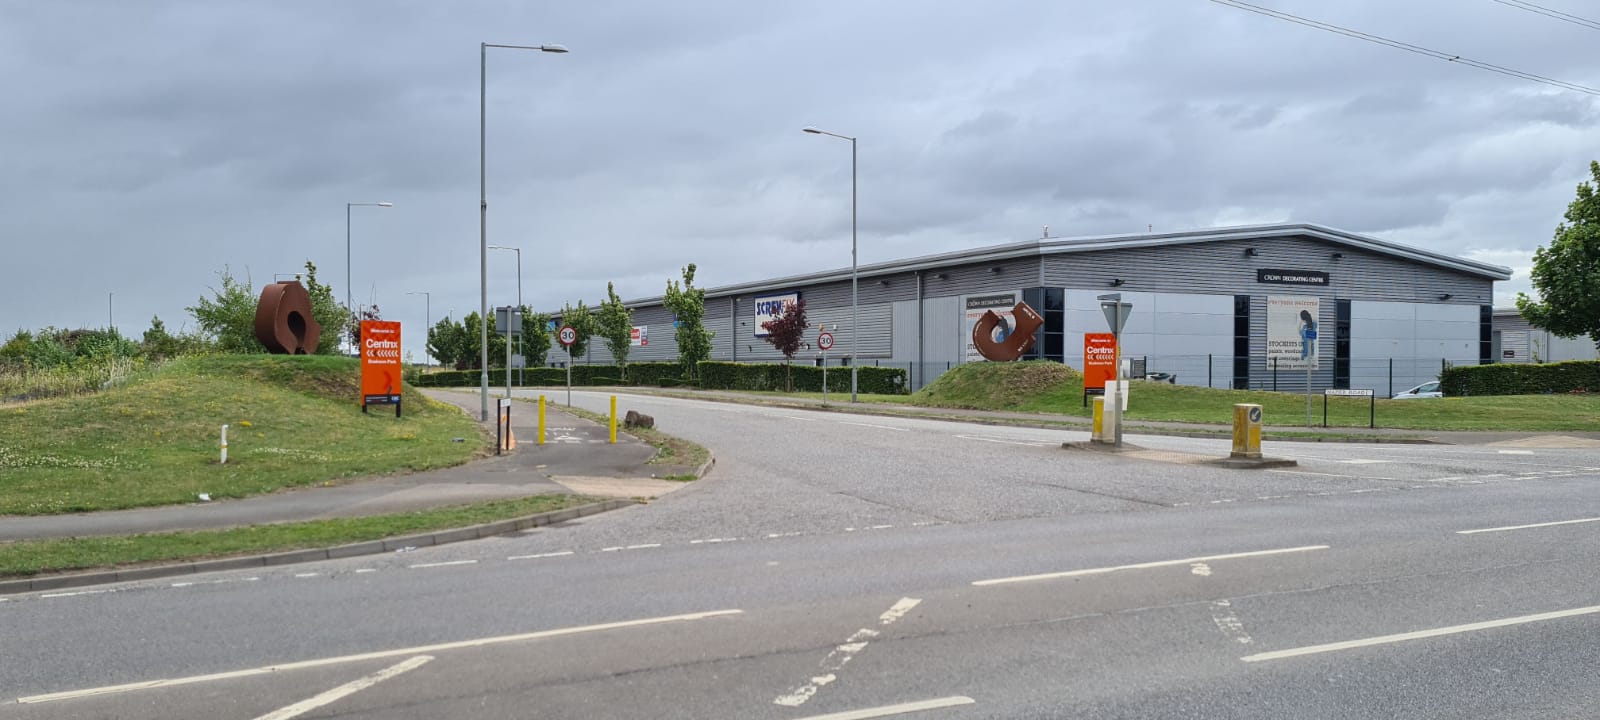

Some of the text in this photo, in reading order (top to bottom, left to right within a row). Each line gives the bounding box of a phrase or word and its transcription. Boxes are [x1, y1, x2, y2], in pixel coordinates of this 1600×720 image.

[561, 331, 575, 340] 30
[366, 338, 398, 348] Centrix
[821, 337, 831, 345] 30
[1087, 345, 1114, 354] Centrix
